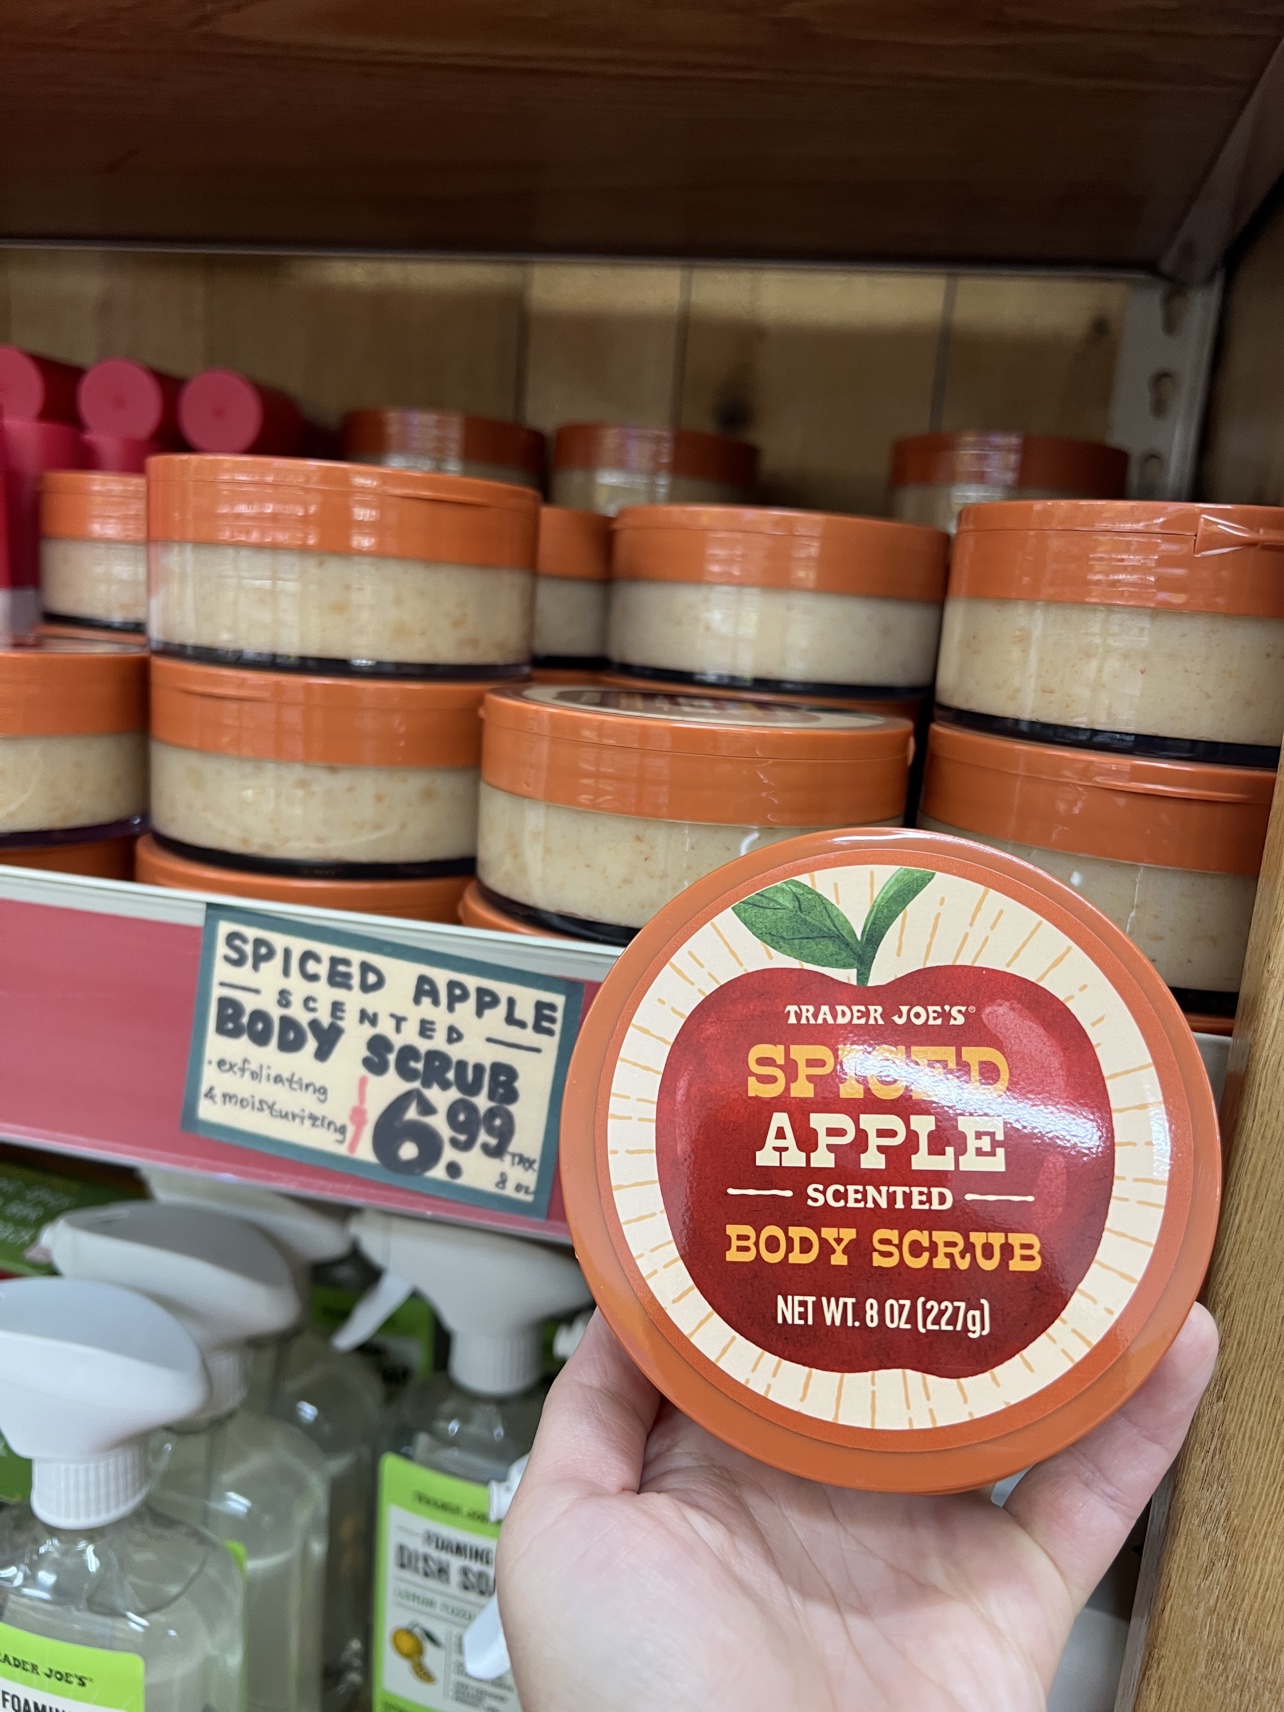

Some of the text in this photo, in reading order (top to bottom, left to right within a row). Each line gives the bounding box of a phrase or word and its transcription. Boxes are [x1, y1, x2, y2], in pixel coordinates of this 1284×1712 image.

[223, 931, 559, 1037] SPICED APPLE
[277, 988, 464, 1045] SCENTED
[785, 1005, 884, 1025] TRADER
[215, 996, 519, 1106] BODY SCRUB
[747, 1043, 1010, 1100] SPICED
[217, 1058, 328, 1103] exfoliating
[222, 1091, 347, 1144] moisturizing
[755, 1112, 1006, 1172] APPLE
[495, 1171, 508, 1190] 8
[806, 1184, 954, 1211] SCENTED
[725, 1224, 1042, 1272] BODY SCRUB
[777, 1295, 990, 1339] NET WT. 8 OZ (227g)
[457, 1564, 496, 1597] SO
